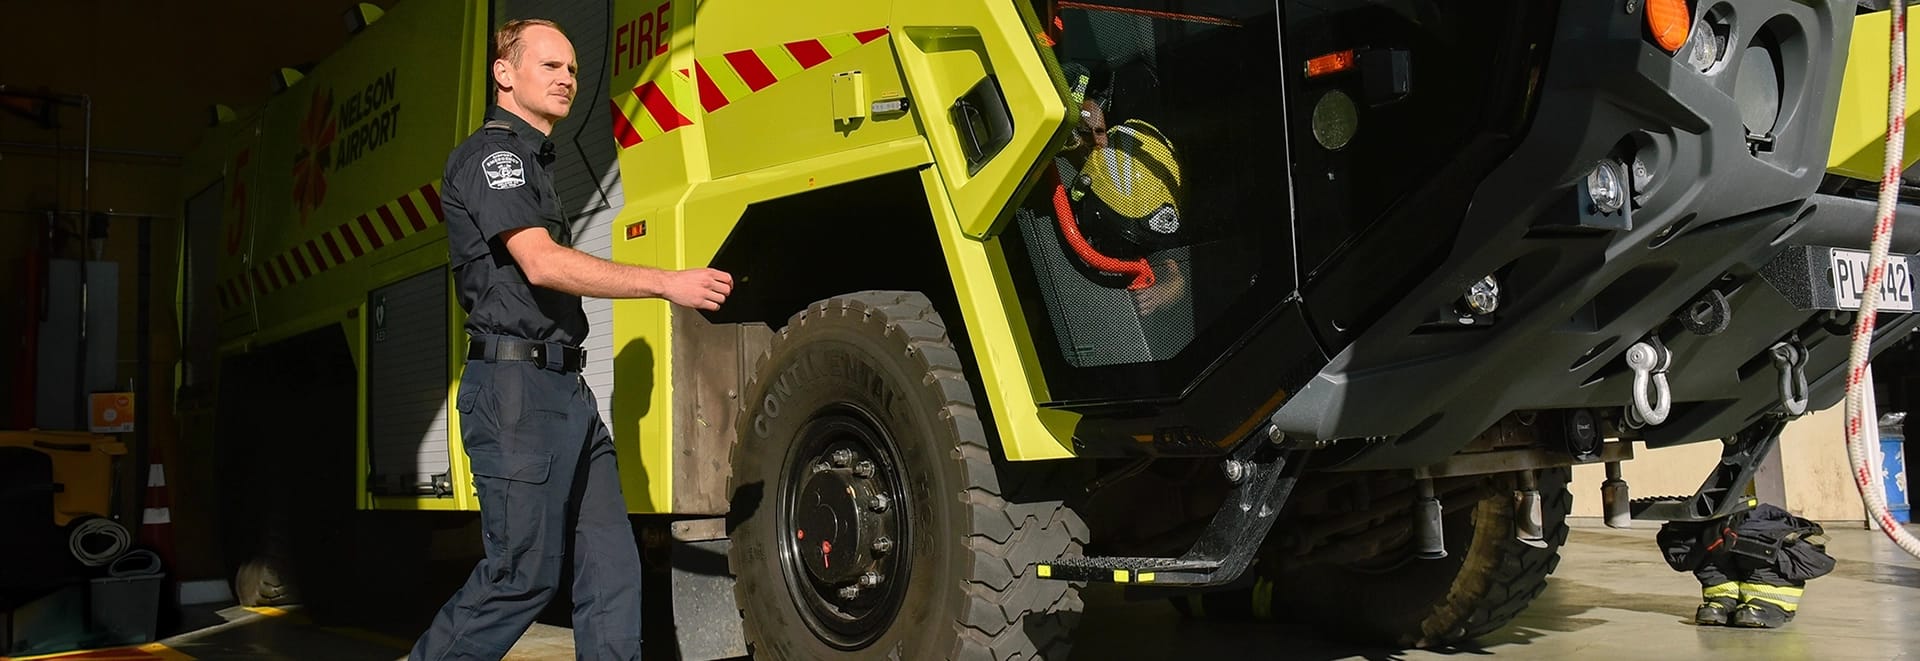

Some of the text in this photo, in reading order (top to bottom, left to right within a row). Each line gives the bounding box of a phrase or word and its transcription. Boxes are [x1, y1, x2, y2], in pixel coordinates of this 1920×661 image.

[615, 2, 671, 77] FIRE
[338, 66, 397, 133] NELSON
[336, 102, 401, 174] AIRPORT
[228, 147, 250, 257] 5
